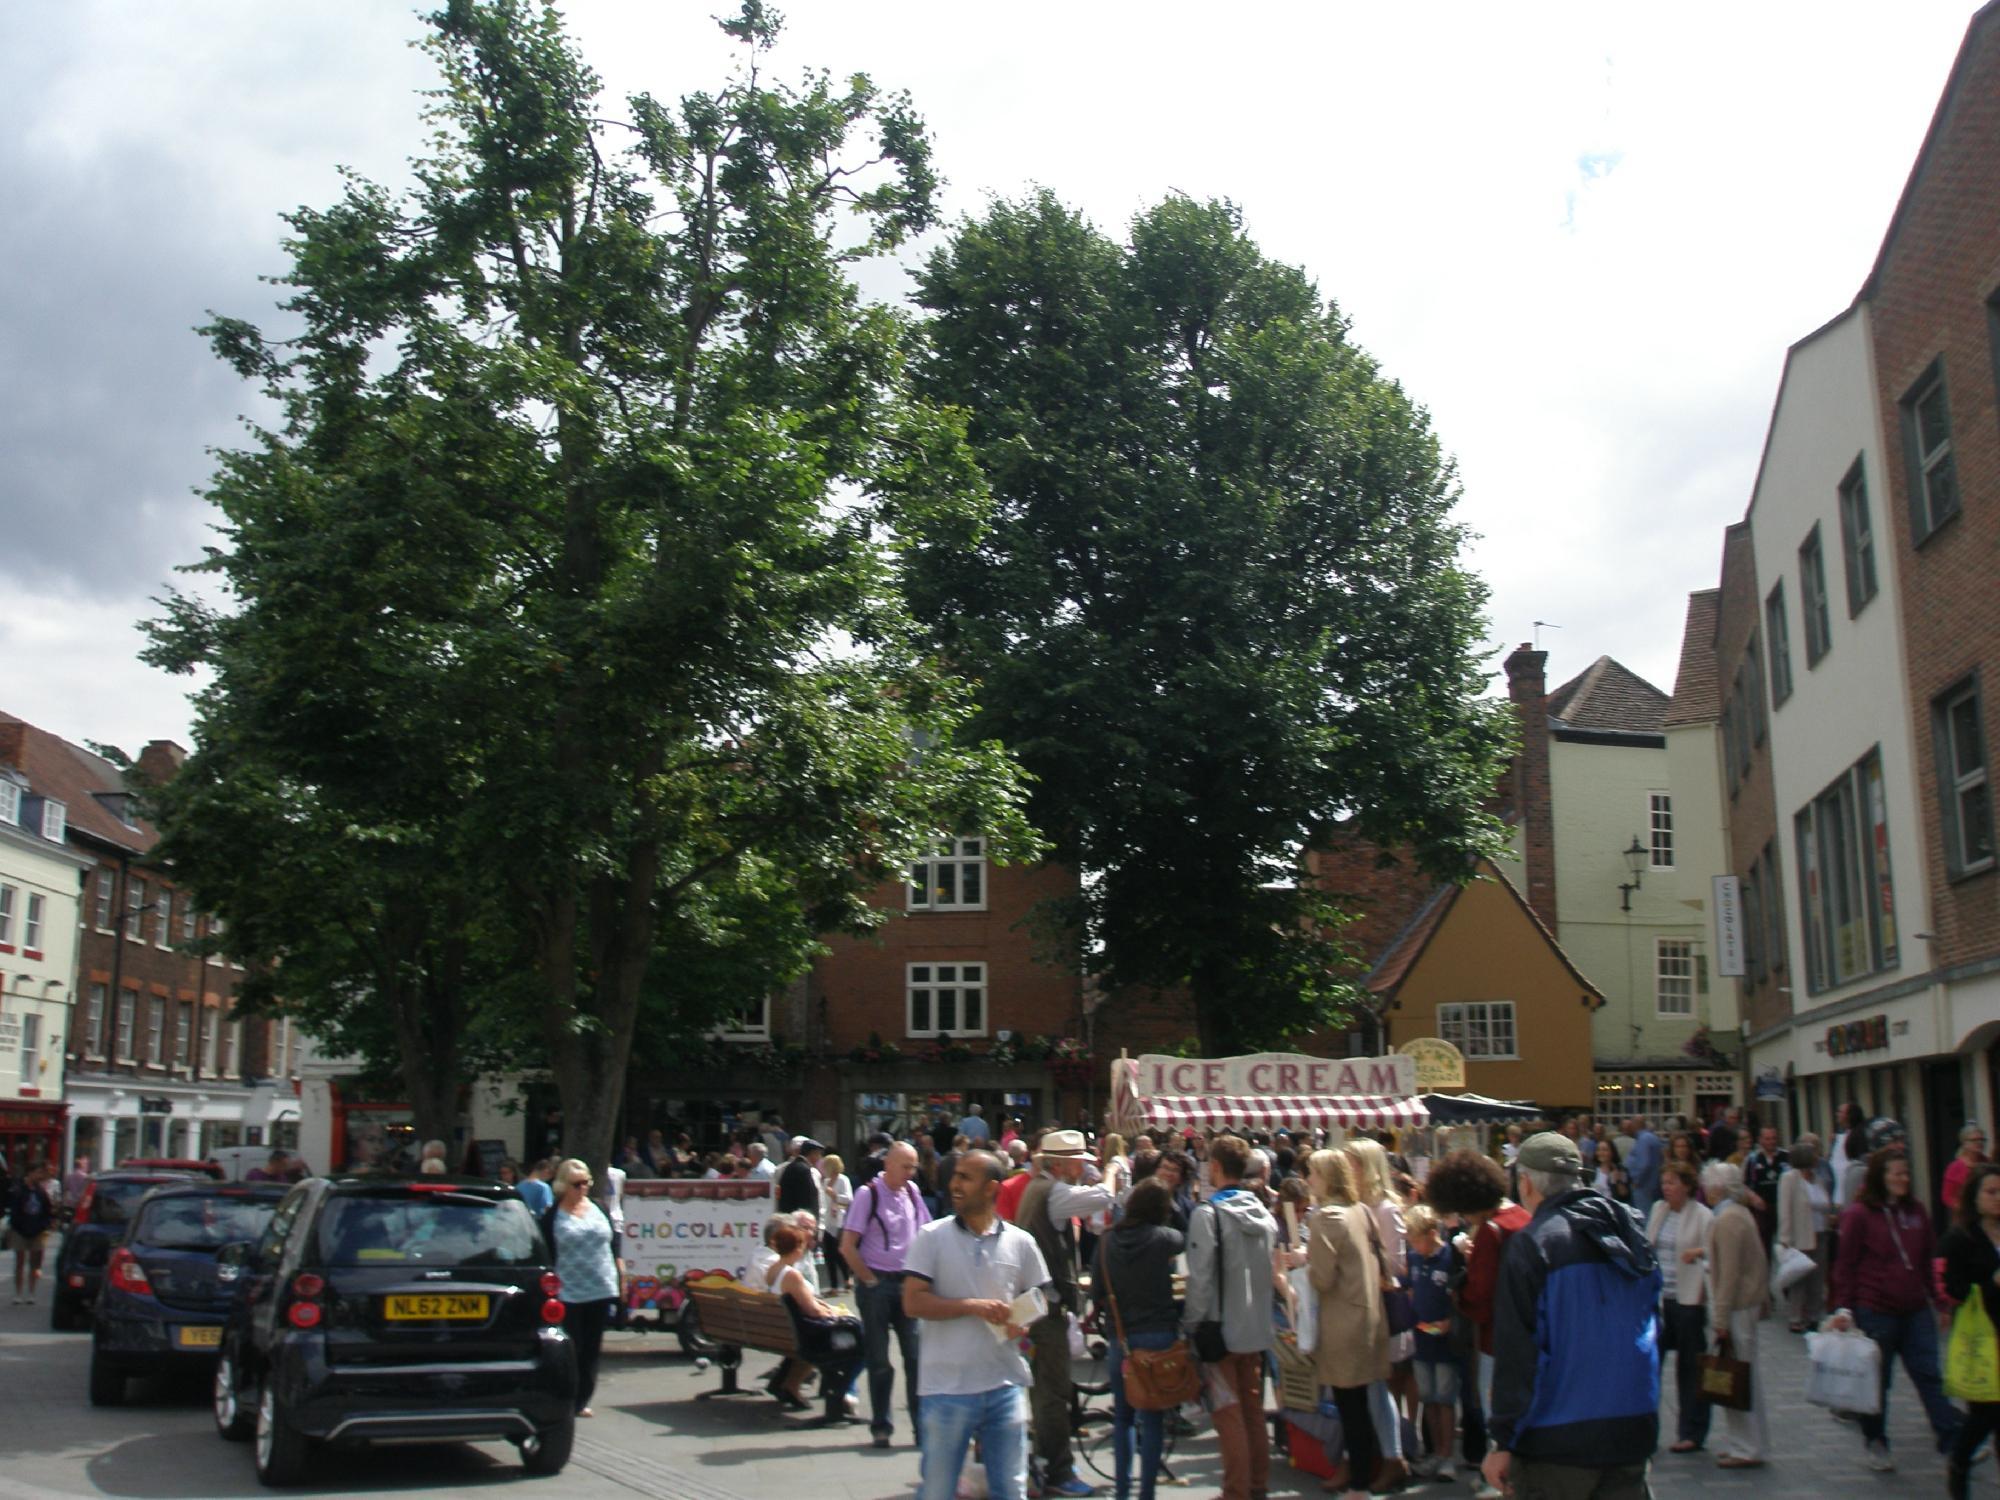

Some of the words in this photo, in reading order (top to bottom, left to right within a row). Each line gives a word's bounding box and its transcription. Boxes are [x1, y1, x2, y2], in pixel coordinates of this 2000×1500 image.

[1152, 1063, 1225, 1095] ICE
[1248, 1062, 1400, 1094] CREAM
[625, 1222, 760, 1239] CHOCOLATE
[393, 1298, 441, 1315] NL62
